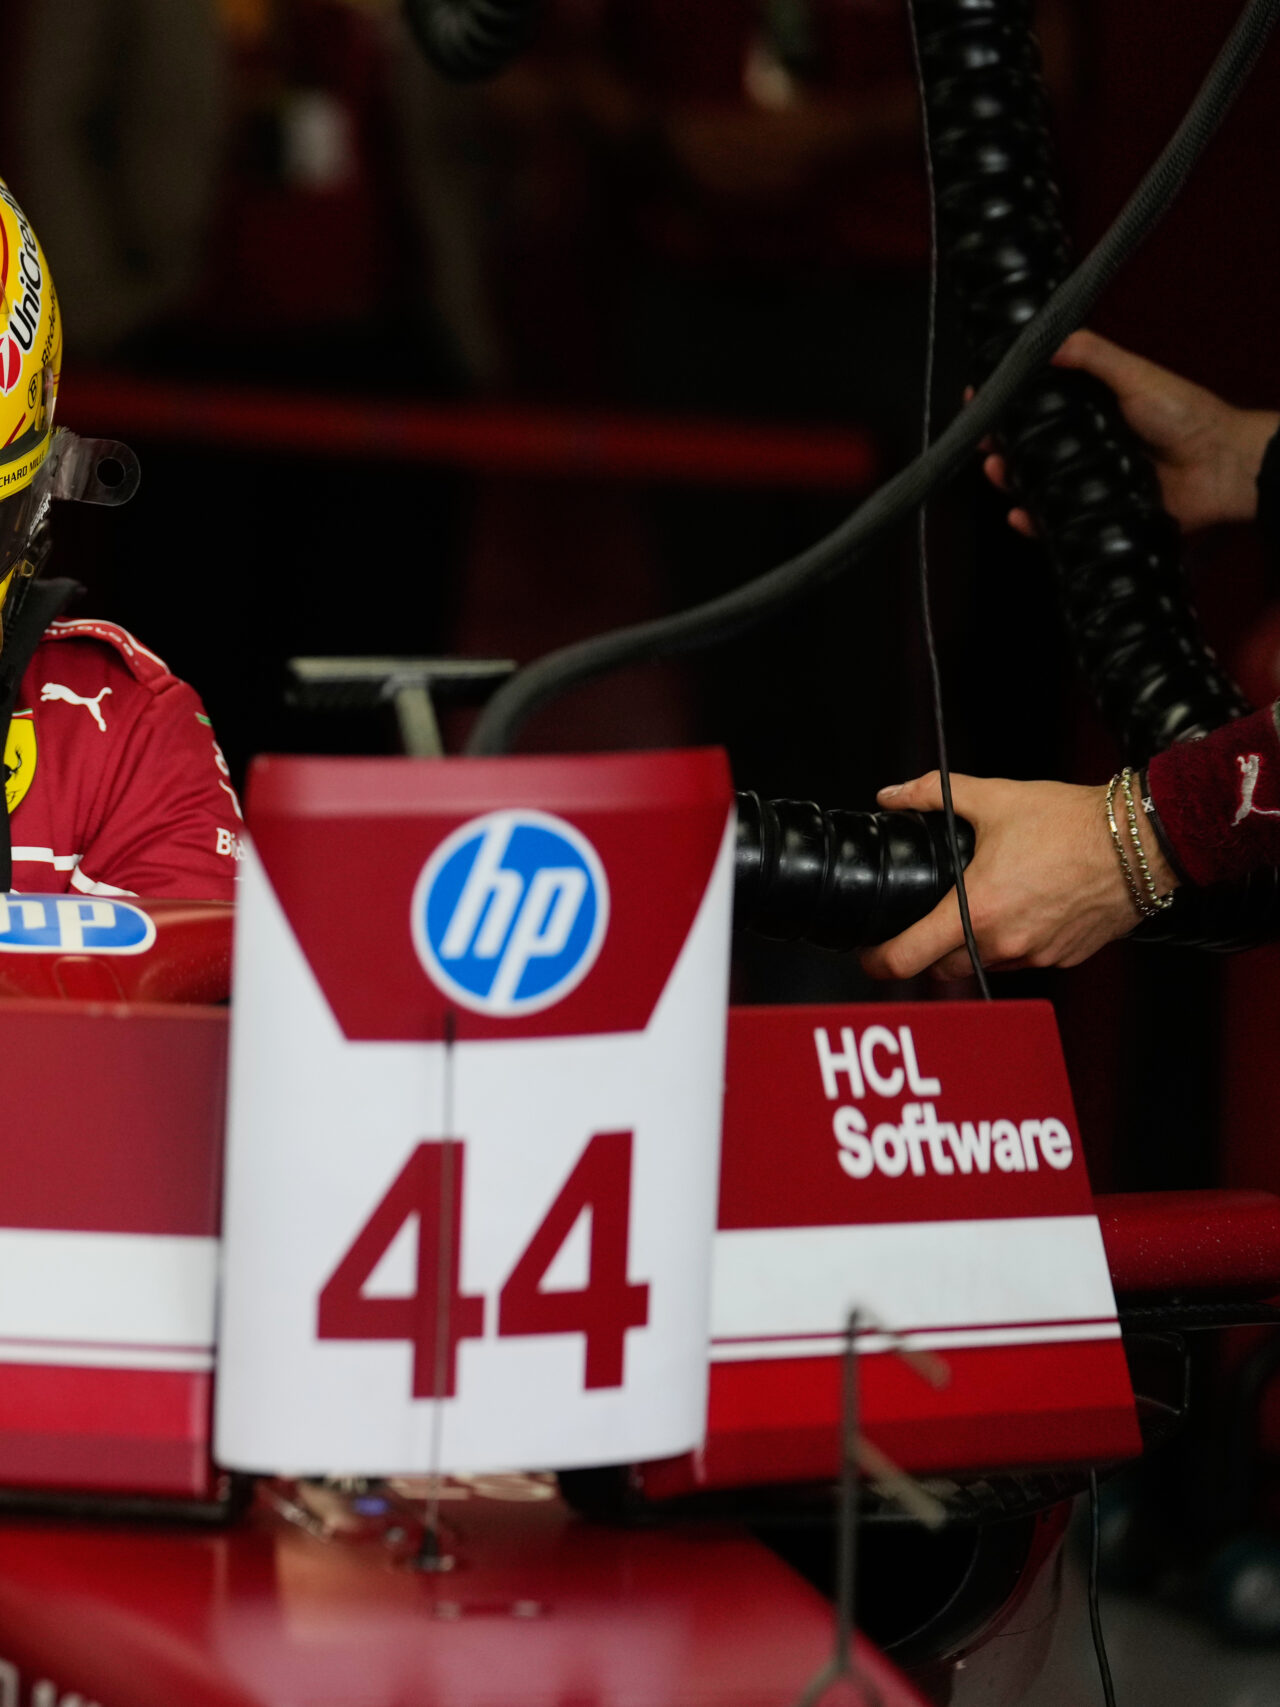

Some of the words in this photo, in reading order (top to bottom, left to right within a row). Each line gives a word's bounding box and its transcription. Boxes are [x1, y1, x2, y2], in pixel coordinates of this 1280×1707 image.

[437, 818, 590, 1006] hp
[813, 1024, 942, 1100] HCL
[832, 1101, 1074, 1180] Software
[315, 1128, 650, 1400] 44
